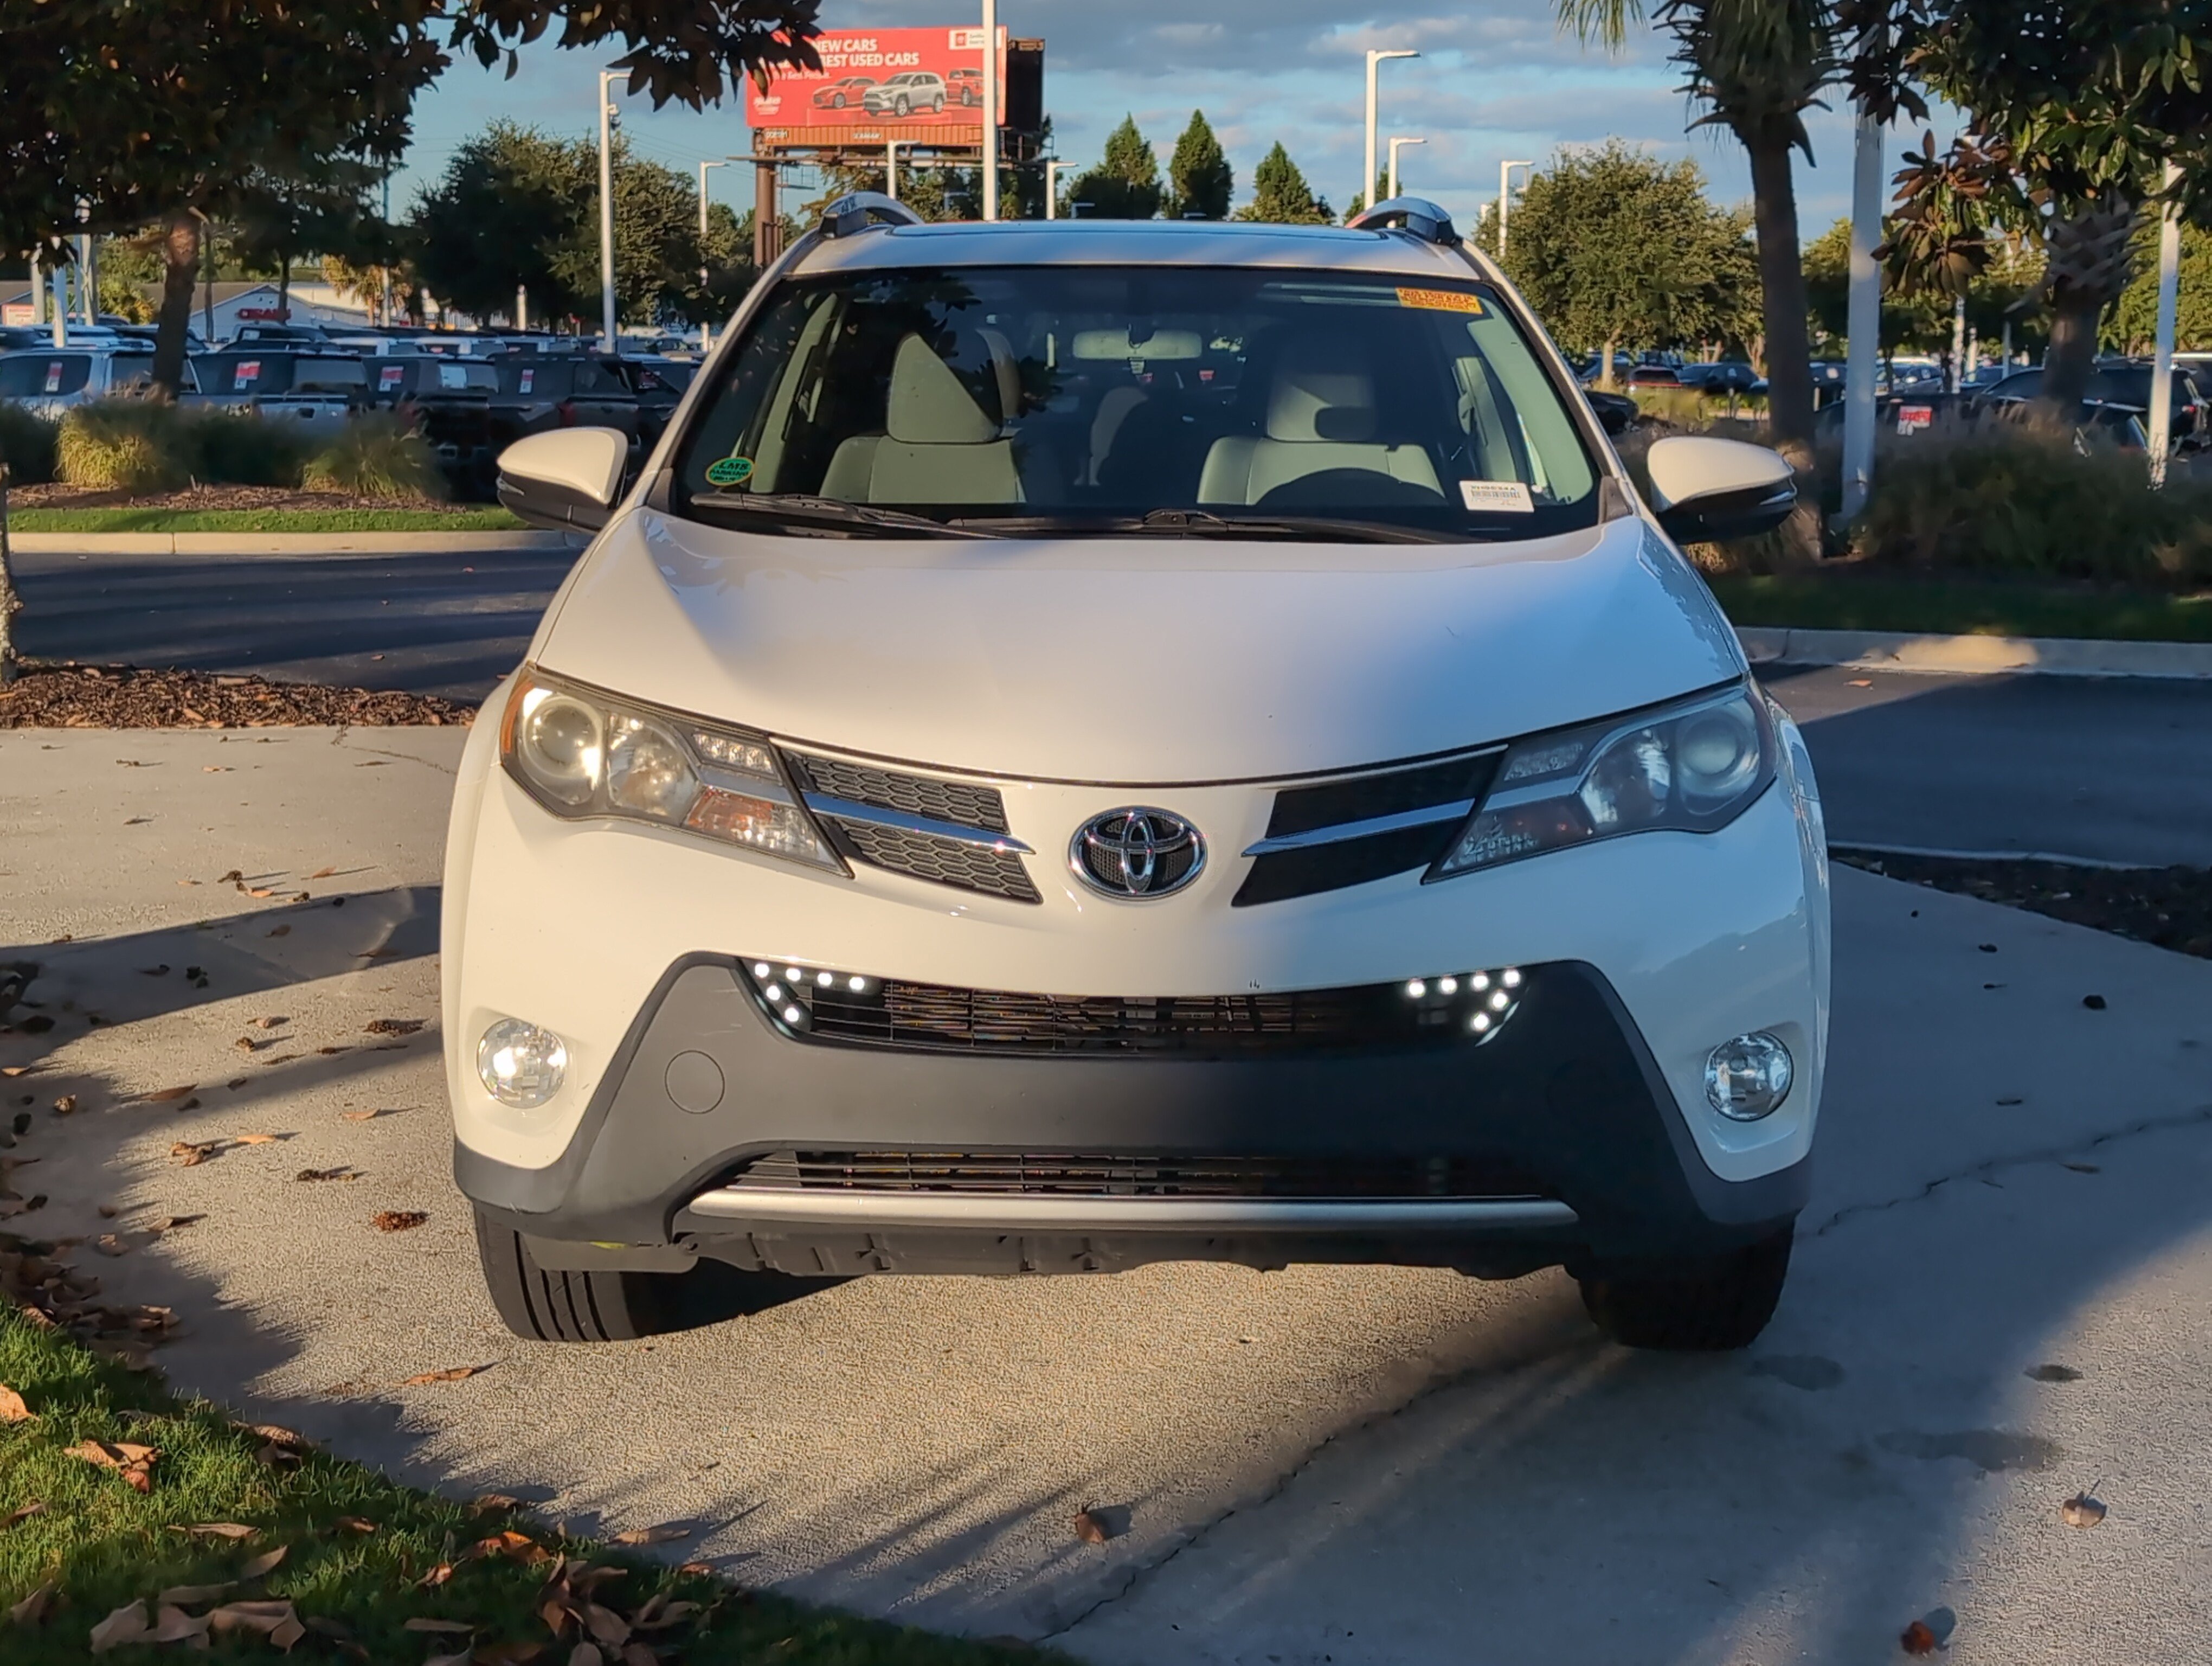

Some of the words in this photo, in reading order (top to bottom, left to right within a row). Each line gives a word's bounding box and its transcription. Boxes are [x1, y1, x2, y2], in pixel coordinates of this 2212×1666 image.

[843, 39, 877, 52] CARS
[849, 53, 884, 66] USED
[885, 53, 919, 66] CARS
